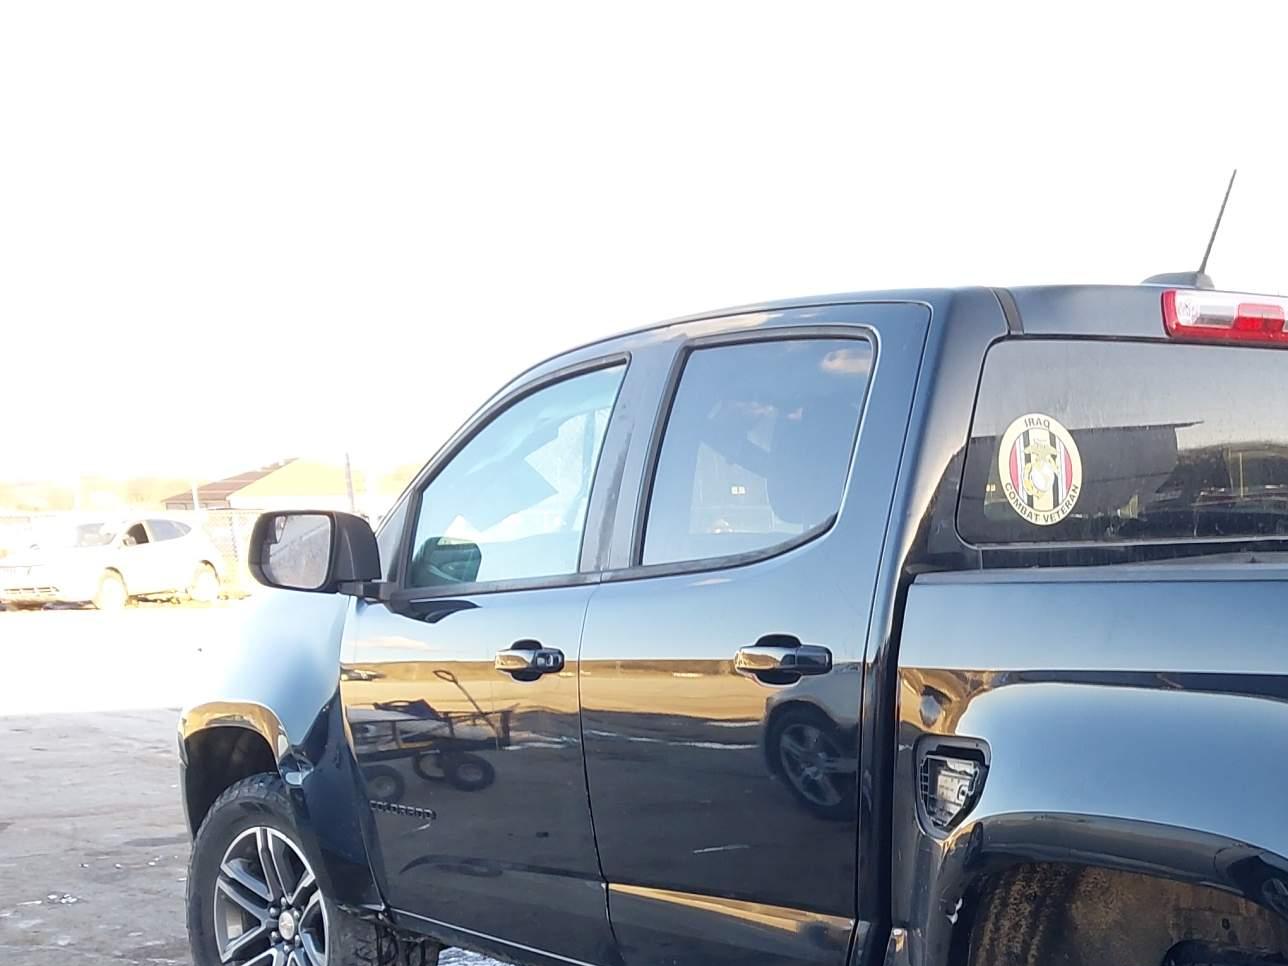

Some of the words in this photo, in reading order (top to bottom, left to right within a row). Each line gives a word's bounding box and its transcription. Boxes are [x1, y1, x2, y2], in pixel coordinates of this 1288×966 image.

[1024, 418, 1050, 429] IRAQ
[1004, 482, 1041, 522] COMBAT
[1043, 484, 1079, 523] VETERAN
